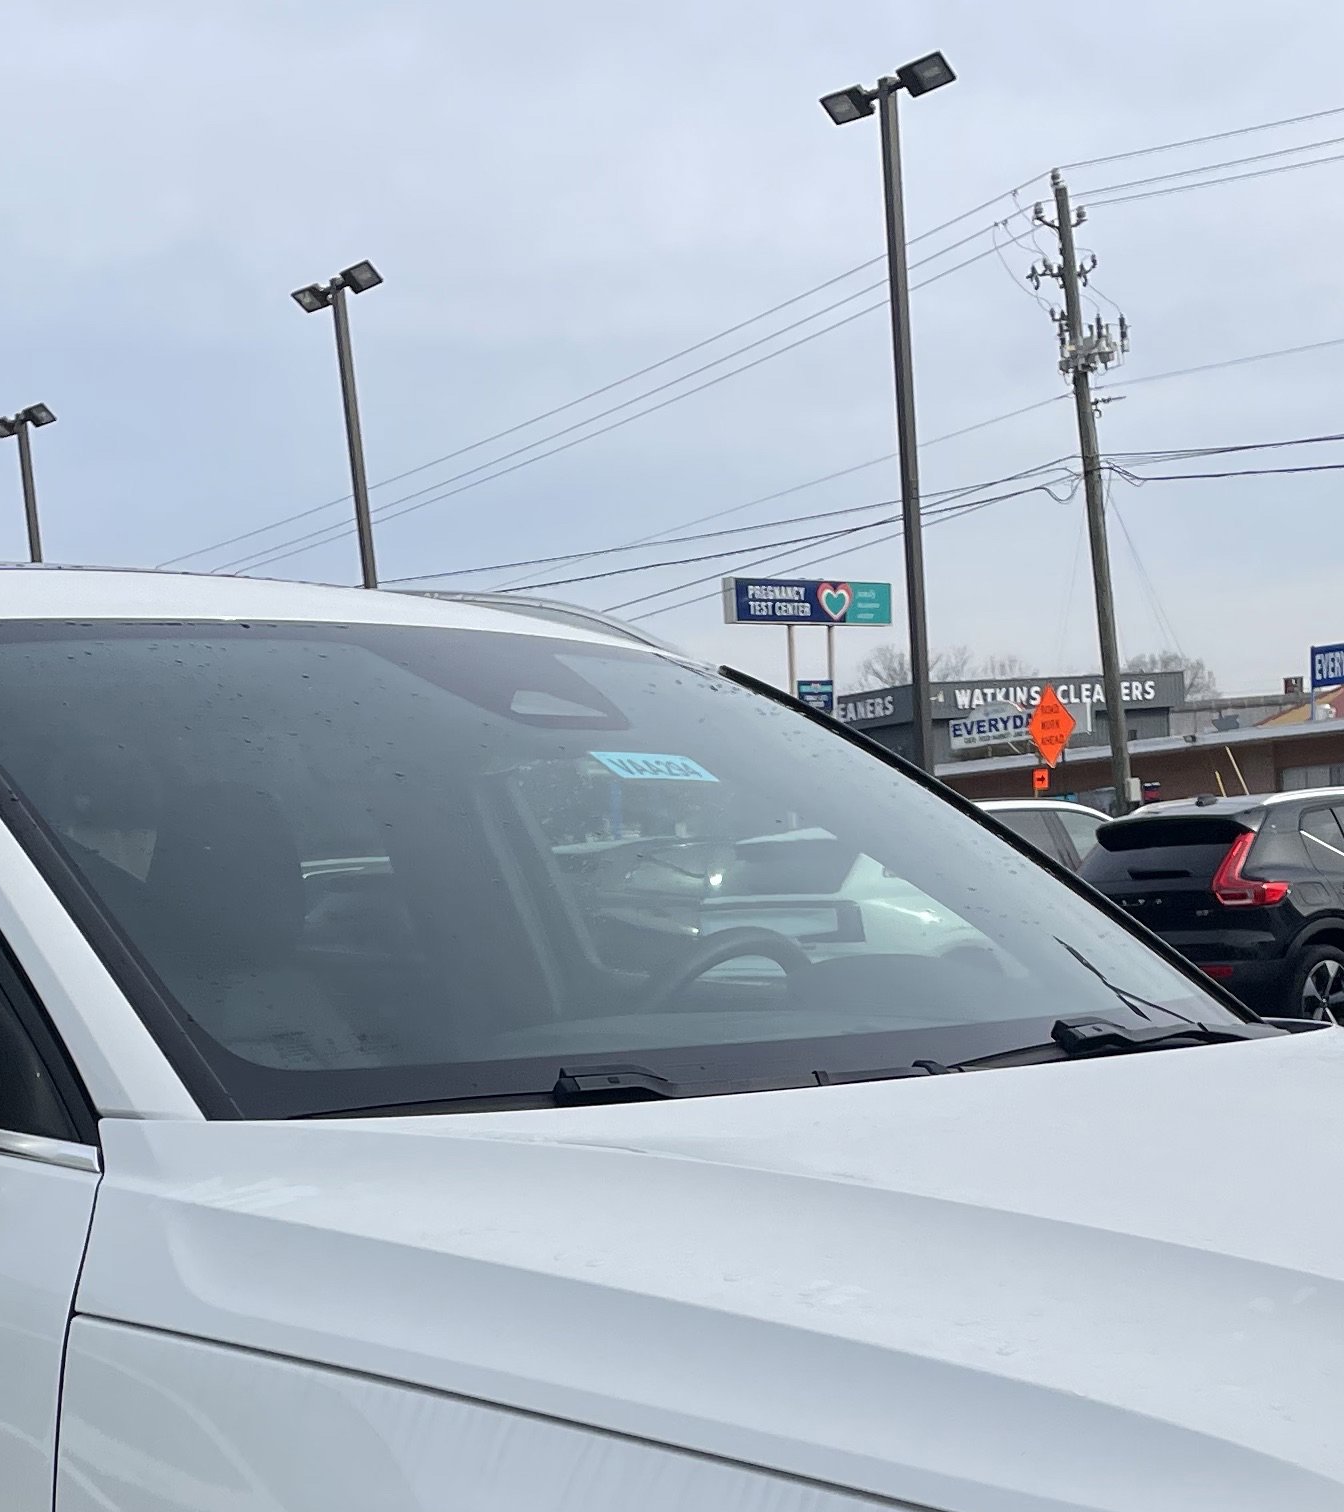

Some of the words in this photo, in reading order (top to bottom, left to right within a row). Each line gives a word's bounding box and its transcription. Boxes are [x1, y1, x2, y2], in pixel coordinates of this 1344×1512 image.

[747, 585, 806, 600] PREGNANCY
[748, 601, 773, 615] TEST
[774, 602, 811, 616] CENTER
[955, 686, 1041, 709] WATKINS
[1057, 681, 1156, 704] CLEAERS
[838, 695, 894, 722] EANERS
[951, 713, 1033, 737] EVERYDA
